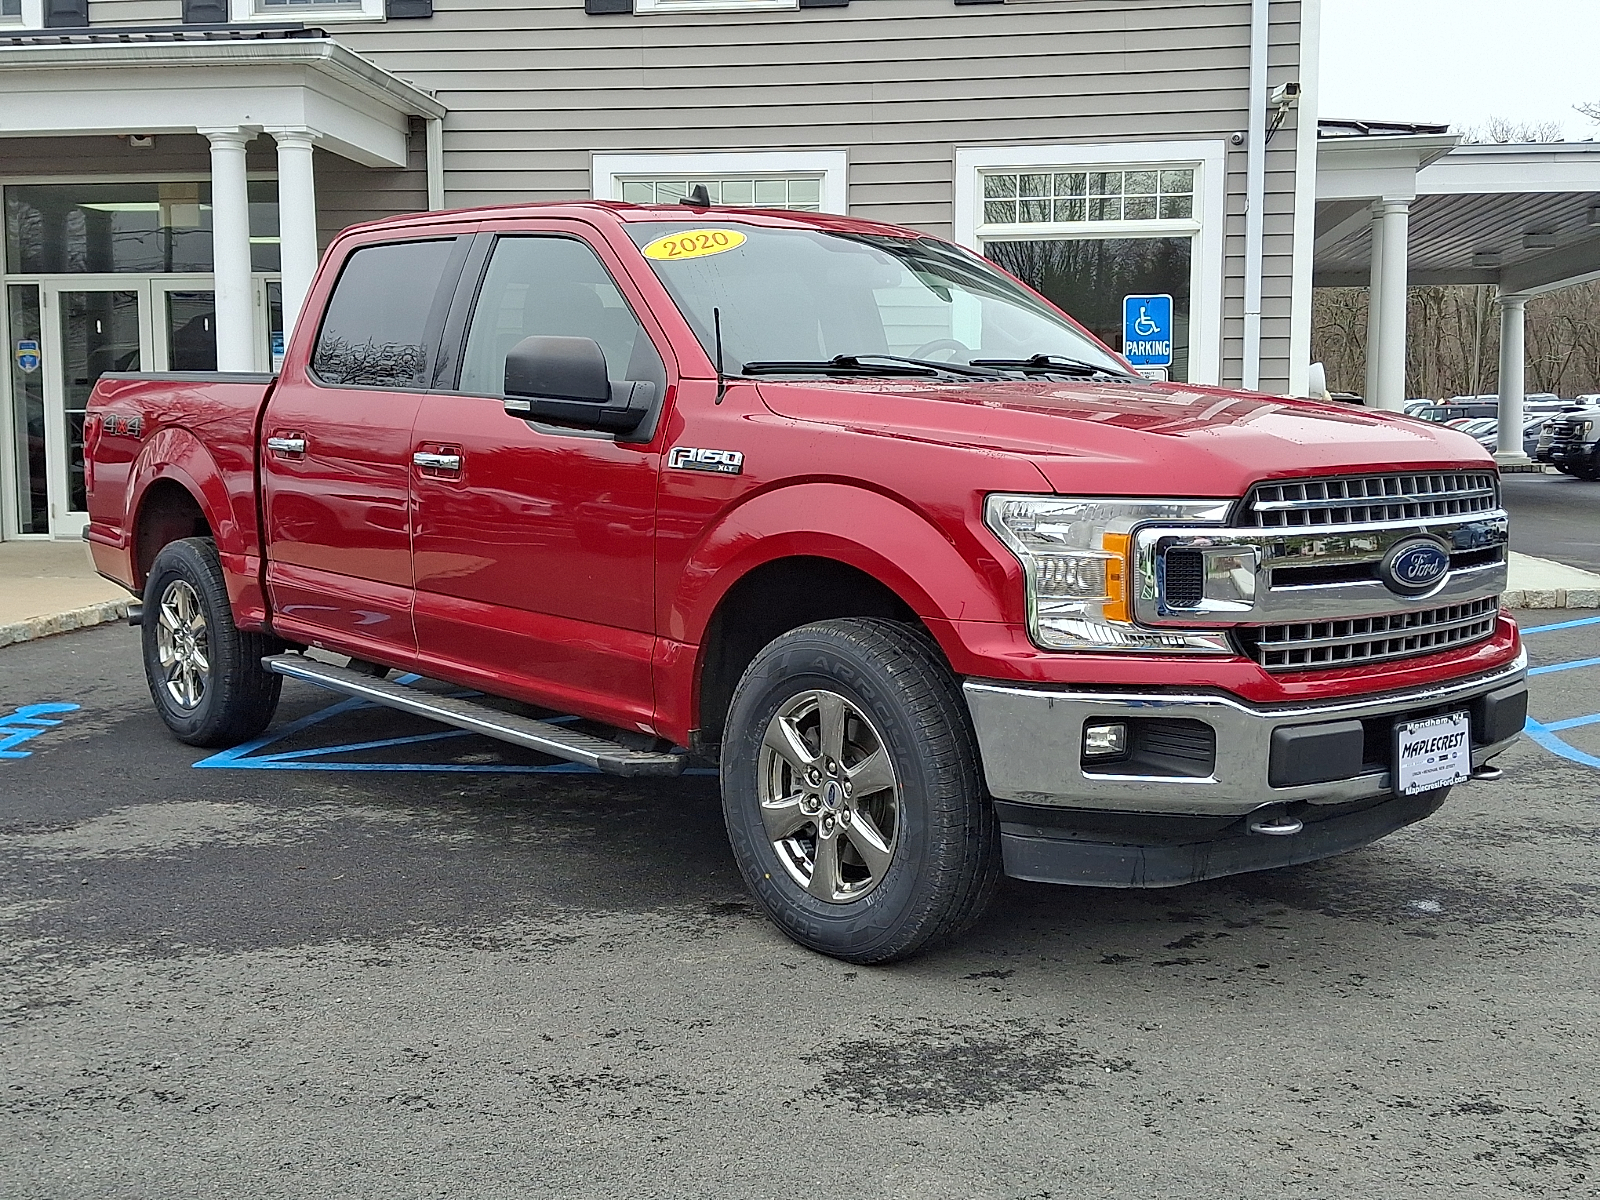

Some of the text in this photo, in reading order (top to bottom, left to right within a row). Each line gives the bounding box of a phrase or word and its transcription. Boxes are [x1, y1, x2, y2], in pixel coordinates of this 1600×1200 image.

[663, 232, 729, 256] 2020
[1126, 340, 1170, 356] PARKING
[717, 464, 734, 472] XLT
[1408, 553, 1440, 578] Ford
[1402, 732, 1465, 758] MAPLECREST
